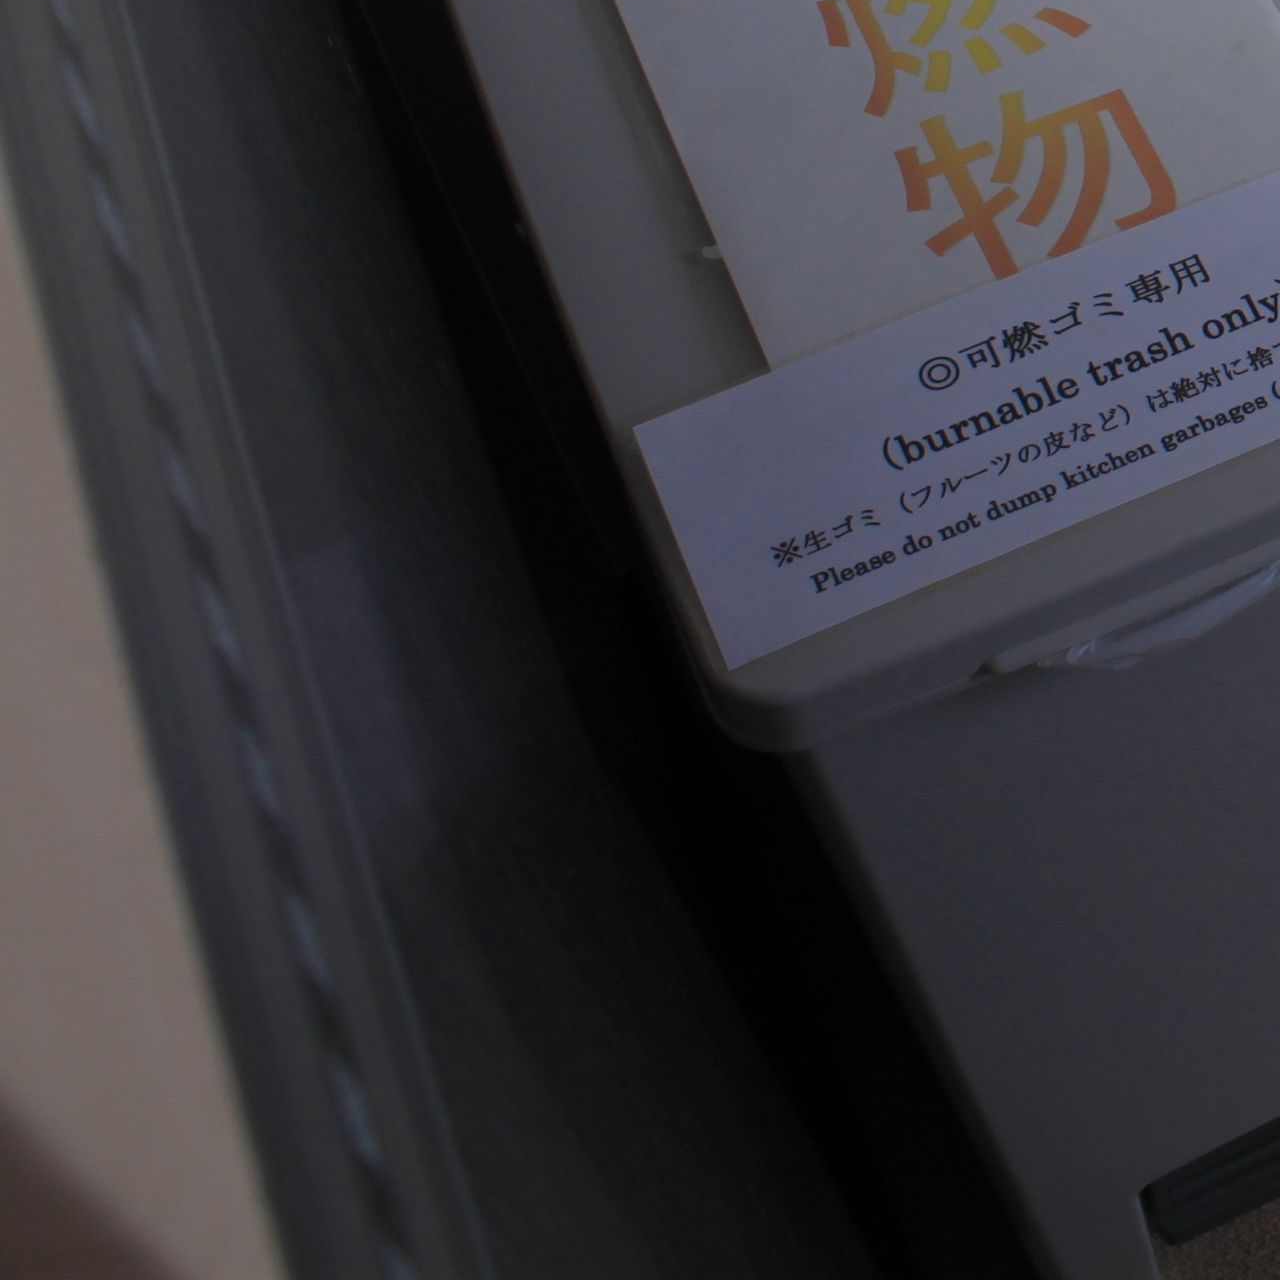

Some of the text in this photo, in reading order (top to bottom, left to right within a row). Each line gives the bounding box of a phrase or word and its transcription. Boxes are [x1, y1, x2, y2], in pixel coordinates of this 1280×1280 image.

[883, 376, 1080, 471] (burnable
[1087, 327, 1195, 386] trash
[809, 550, 897, 594] Please
[903, 534, 933, 558] do
[938, 511, 982, 543] not
[987, 482, 1057, 522] dump
[1059, 441, 1156, 490] kitchen
[1160, 395, 1269, 452] garbages
